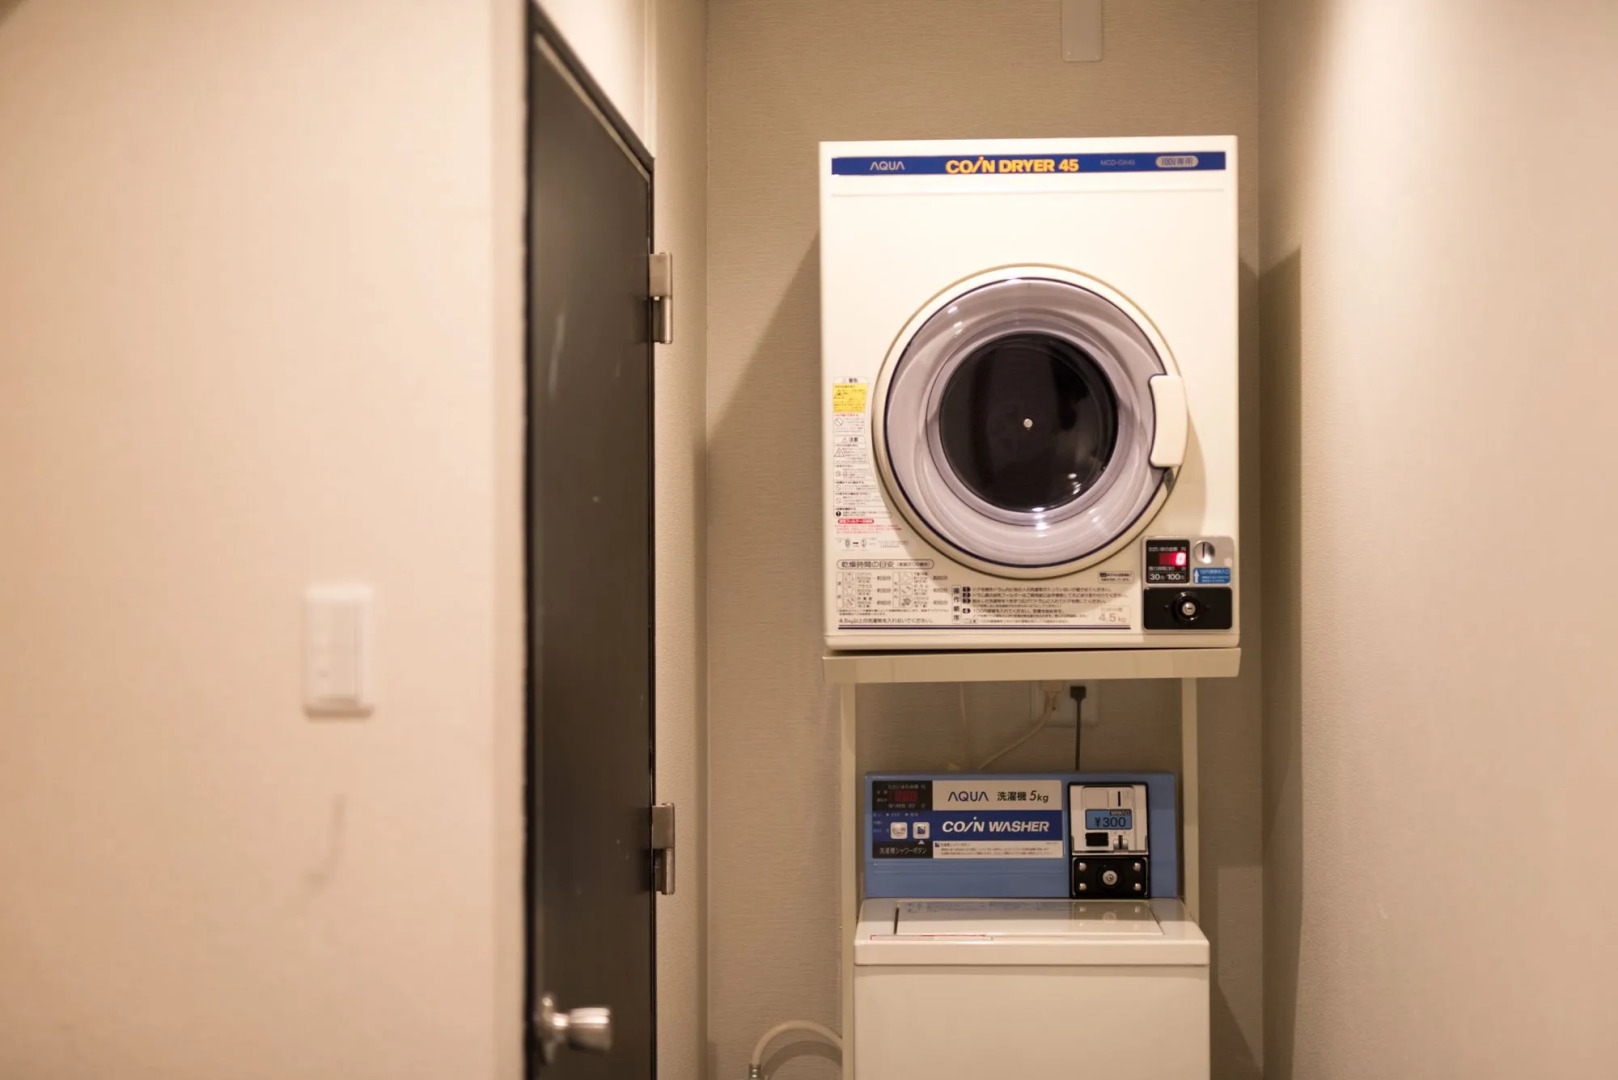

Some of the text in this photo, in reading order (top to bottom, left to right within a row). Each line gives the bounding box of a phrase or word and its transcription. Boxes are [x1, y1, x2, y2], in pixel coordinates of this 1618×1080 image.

[869, 161, 905, 171] AQUA
[945, 155, 1079, 174] COIN DRYER 45
[1175, 552, 1186, 565] 0
[947, 791, 989, 802] AQUA
[997, 790, 1049, 803] 洗濯機 5kg
[942, 816, 1050, 833] COIN WASHER
[1094, 816, 1127, 828] ¥300
